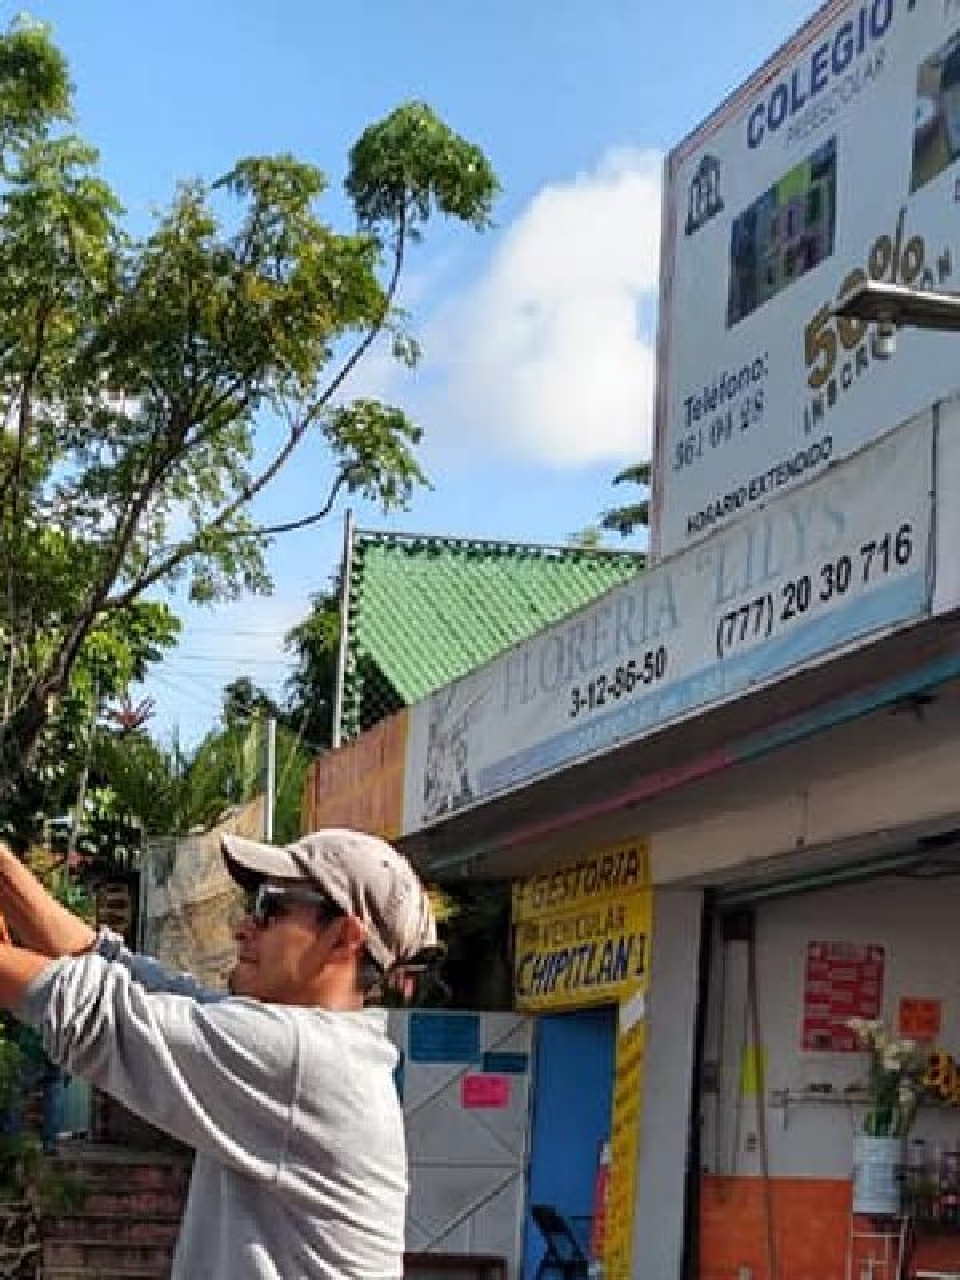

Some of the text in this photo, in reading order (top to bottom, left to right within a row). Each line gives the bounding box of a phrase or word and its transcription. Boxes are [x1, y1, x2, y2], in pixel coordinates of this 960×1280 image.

[746, 0, 893, 149] COLEGIO
[687, 435, 833, 532] HORARIO EXTENDIDO
[715, 522, 914, 659] (777) 20 30 716
[532, 848, 638, 911] GESTORIA
